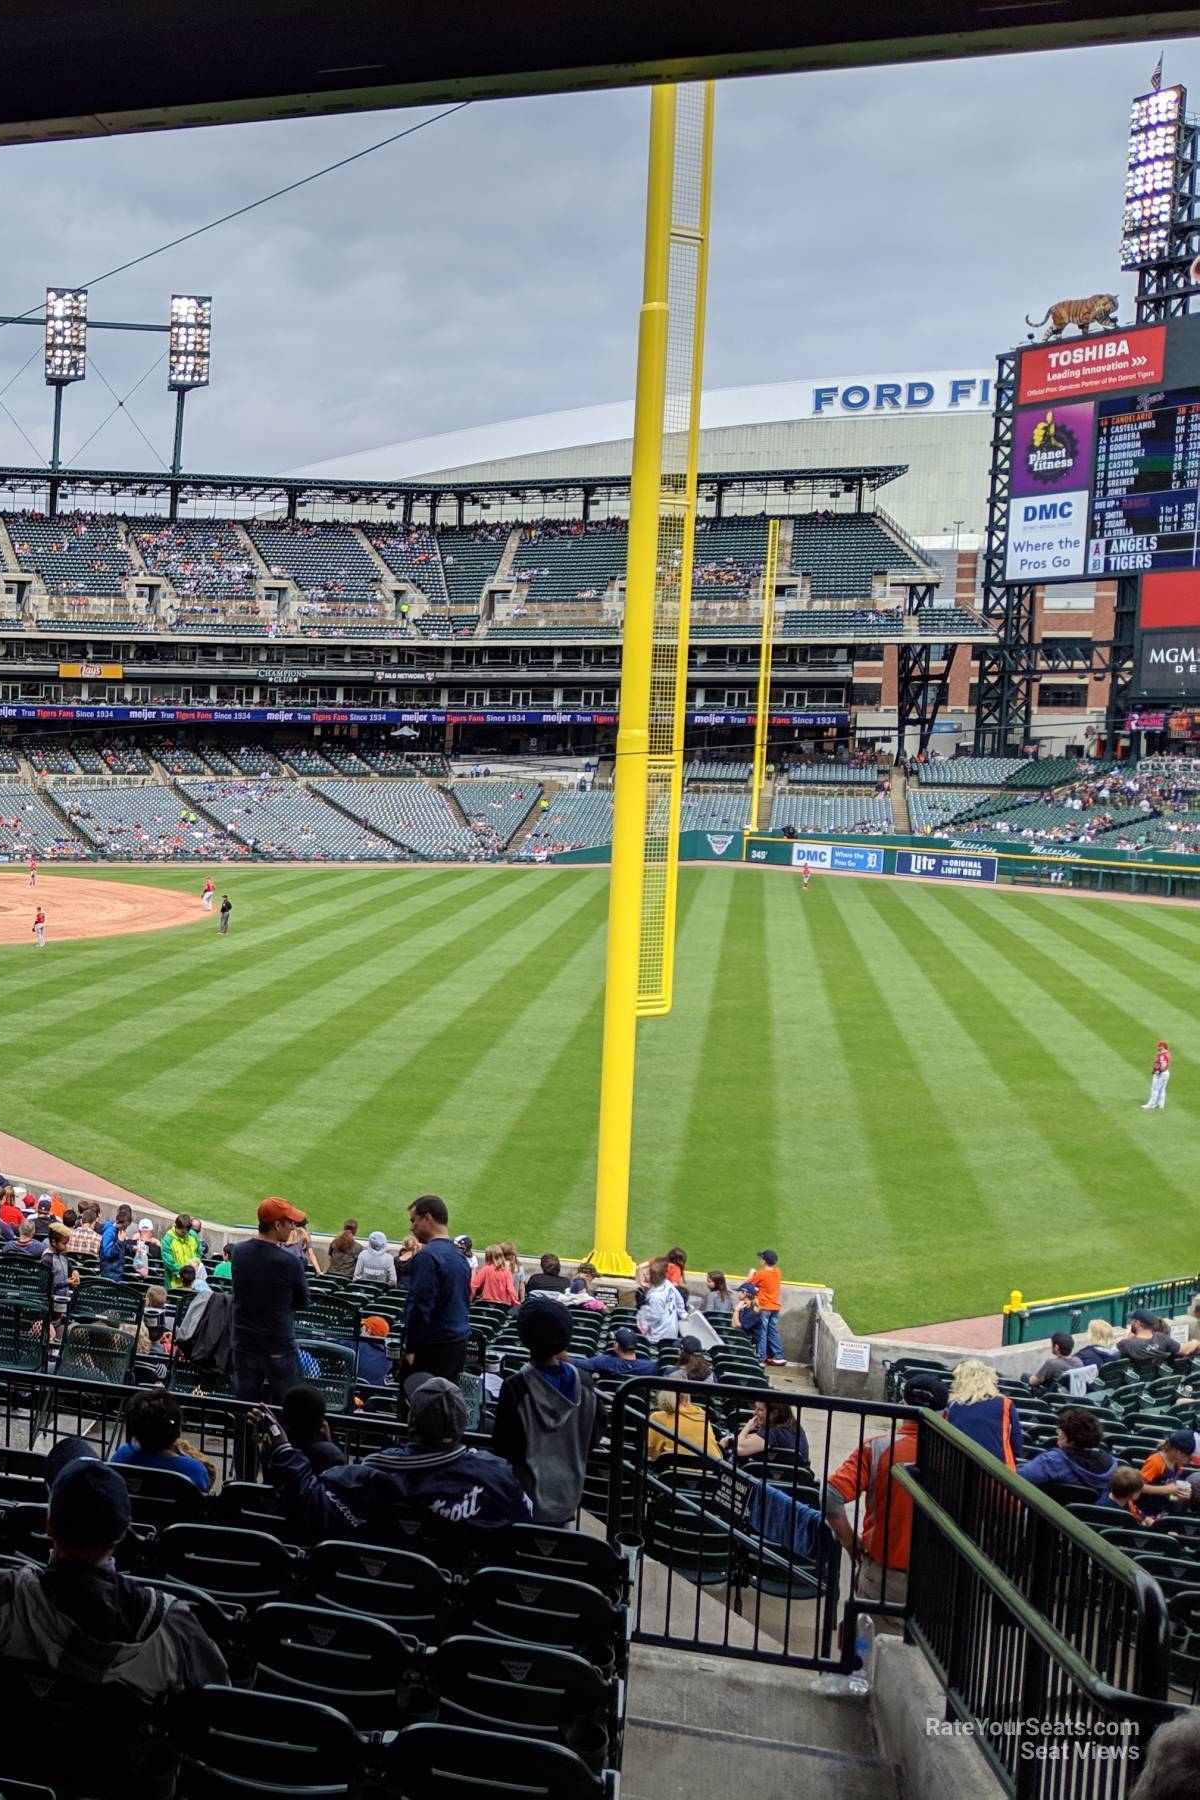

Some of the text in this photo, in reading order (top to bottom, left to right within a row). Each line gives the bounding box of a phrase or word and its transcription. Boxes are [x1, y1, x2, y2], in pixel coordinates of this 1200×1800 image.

[1048, 340, 1130, 368] TOSHIBA
[1047, 361, 1129, 382] Leading Innovation
[1026, 388, 1045, 397] Official
[1058, 383, 1081, 392] Services
[1081, 379, 1101, 388] Partner
[1108, 375, 1117, 383] the
[1117, 373, 1137, 382] Detroit
[1137, 370, 1155, 380] Tigers
[813, 378, 991, 414] FORD FI
[1110, 416, 1185, 434] CASTELLANOS RF
[1111, 412, 1153, 425] CANDELARIO
[1099, 436, 1107, 444] 24
[1110, 432, 1140, 443] CABRERA
[1109, 435, 1183, 452] GOODRUM LF
[1028, 447, 1067, 465] planet
[1109, 449, 1145, 461] RODRIGUEZ
[1033, 458, 1073, 471] fitness
[1108, 459, 1134, 469] CASTRO
[1108, 462, 1182, 479] BECKHAM SS
[1096, 480, 1104, 488] 17
[1107, 477, 1135, 488] GREINER
[1172, 471, 1177, 480] C
[1095, 481, 1180, 498] 21 JONES CF
[1106, 500, 1115, 508] UP
[1023, 501, 1073, 522] DMC
[1105, 505, 1173, 520] SMITH for
[1104, 514, 1173, 528] COZART for
[1104, 524, 1172, 537] LA STELLA for
[1013, 537, 1080, 553] Where the
[1109, 536, 1158, 554] ANGELS
[1020, 556, 1070, 570] Pros Go
[1109, 554, 1152, 571] TIGERS
[1150, 647, 1194, 663] MGM
[258, 669, 307, 678] CHAMPIONS
[21, 709, 36, 717] True
[37, 709, 57, 720] Tigers
[76, 710, 94, 718] Since
[96, 710, 113, 718] 1934
[129, 710, 156, 721] meijer
[160, 711, 175, 719] True
[176, 711, 195, 721] Tigers
[214, 712, 232, 720] Since
[234, 712, 251, 720] 1934
[266, 711, 293, 722] meijer
[312, 713, 332, 722] Tigers
[333, 713, 348, 721] Fans
[349, 713, 368, 721] Since
[369, 713, 386, 721] 1934
[401, 712, 526, 724] meijer True Tigers Fans Since 1934
[542, 712, 571, 724] meijer
[576, 714, 591, 722] True
[592, 714, 615, 725] Tigers
[694, 713, 725, 726] meijer
[730, 716, 747, 724] True
[772, 716, 791, 725] Fans
[792, 716, 814, 725] Since
[816, 717, 837, 725] 1934
[751, 849, 768, 859] 345'
[797, 849, 828, 862] DMC
[834, 850, 865, 859] Where the
[834, 859, 847, 867] Pros
[910, 854, 936, 873] Lite
[949, 860, 982, 869] ORIGINAL
[941, 867, 982, 877] LIGHT BEER
